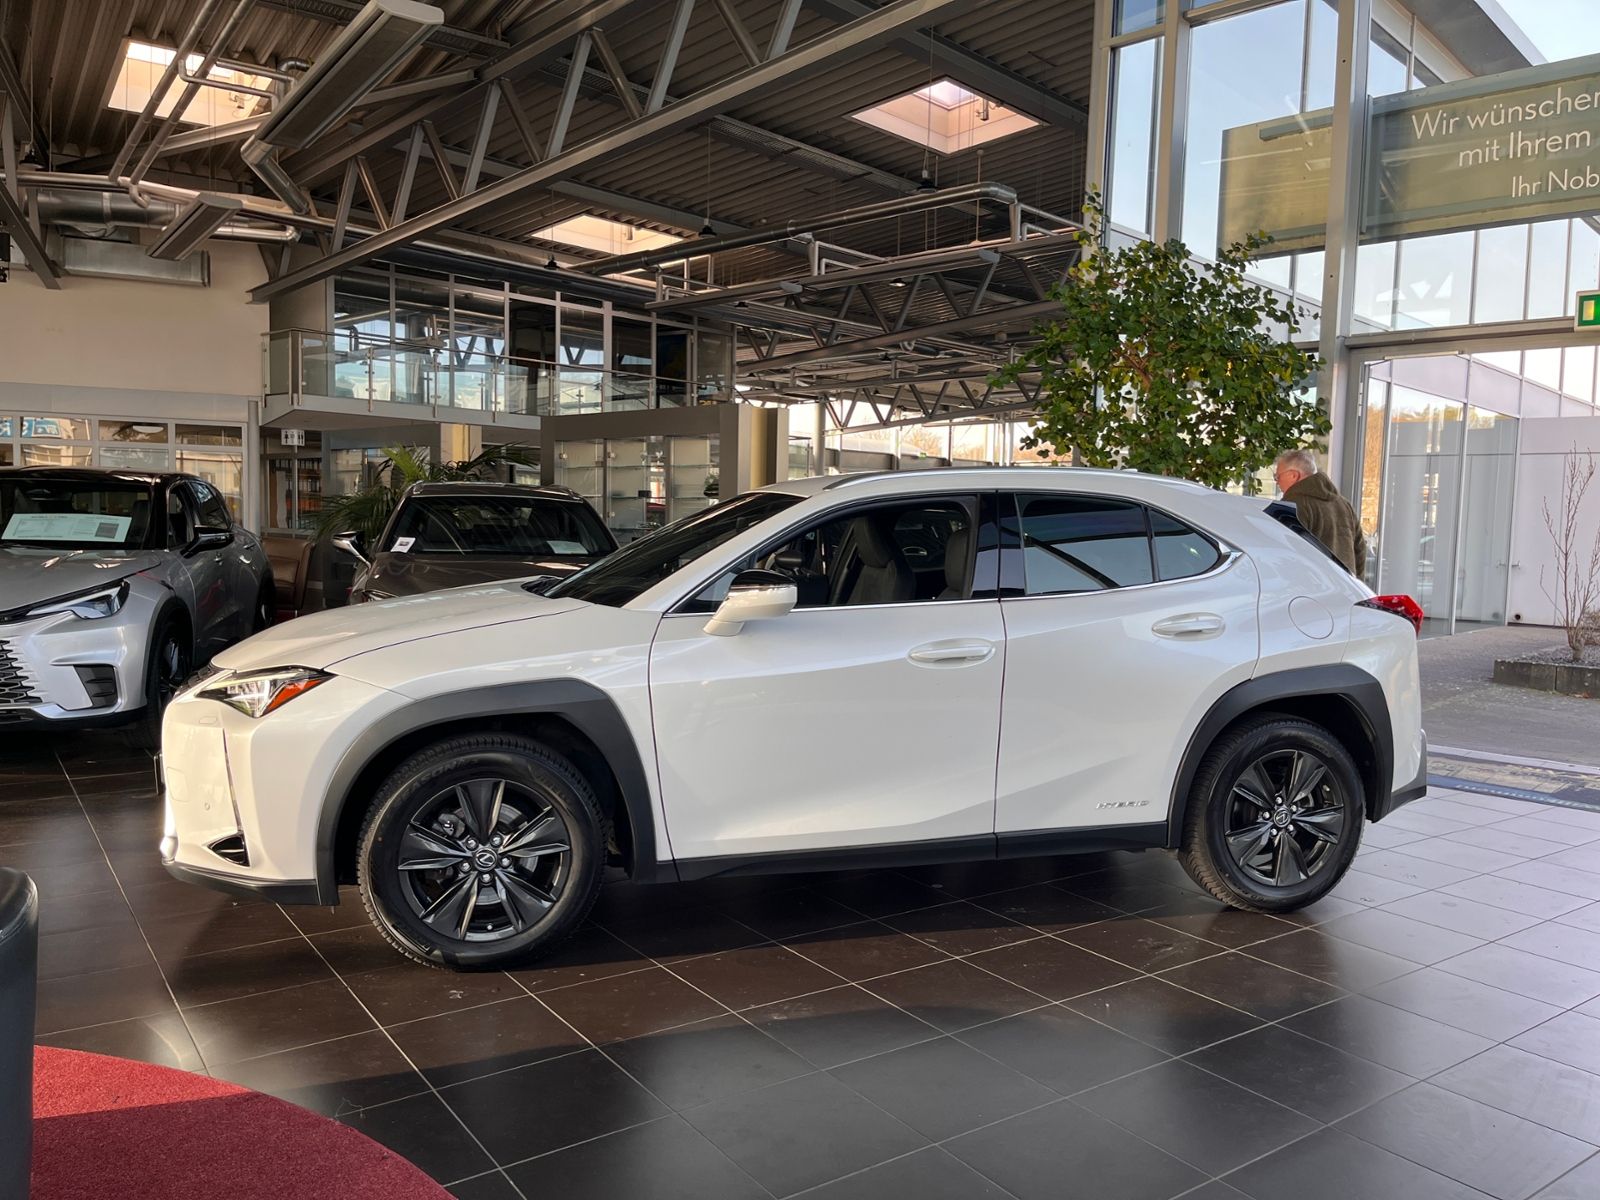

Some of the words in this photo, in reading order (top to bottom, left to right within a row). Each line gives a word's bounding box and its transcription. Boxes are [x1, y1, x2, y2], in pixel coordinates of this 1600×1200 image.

[1412, 109, 1459, 140] Wir
[1459, 139, 1500, 167] mit
[1509, 130, 1591, 160] Ihrem
[1512, 175, 1541, 198] Ihr
